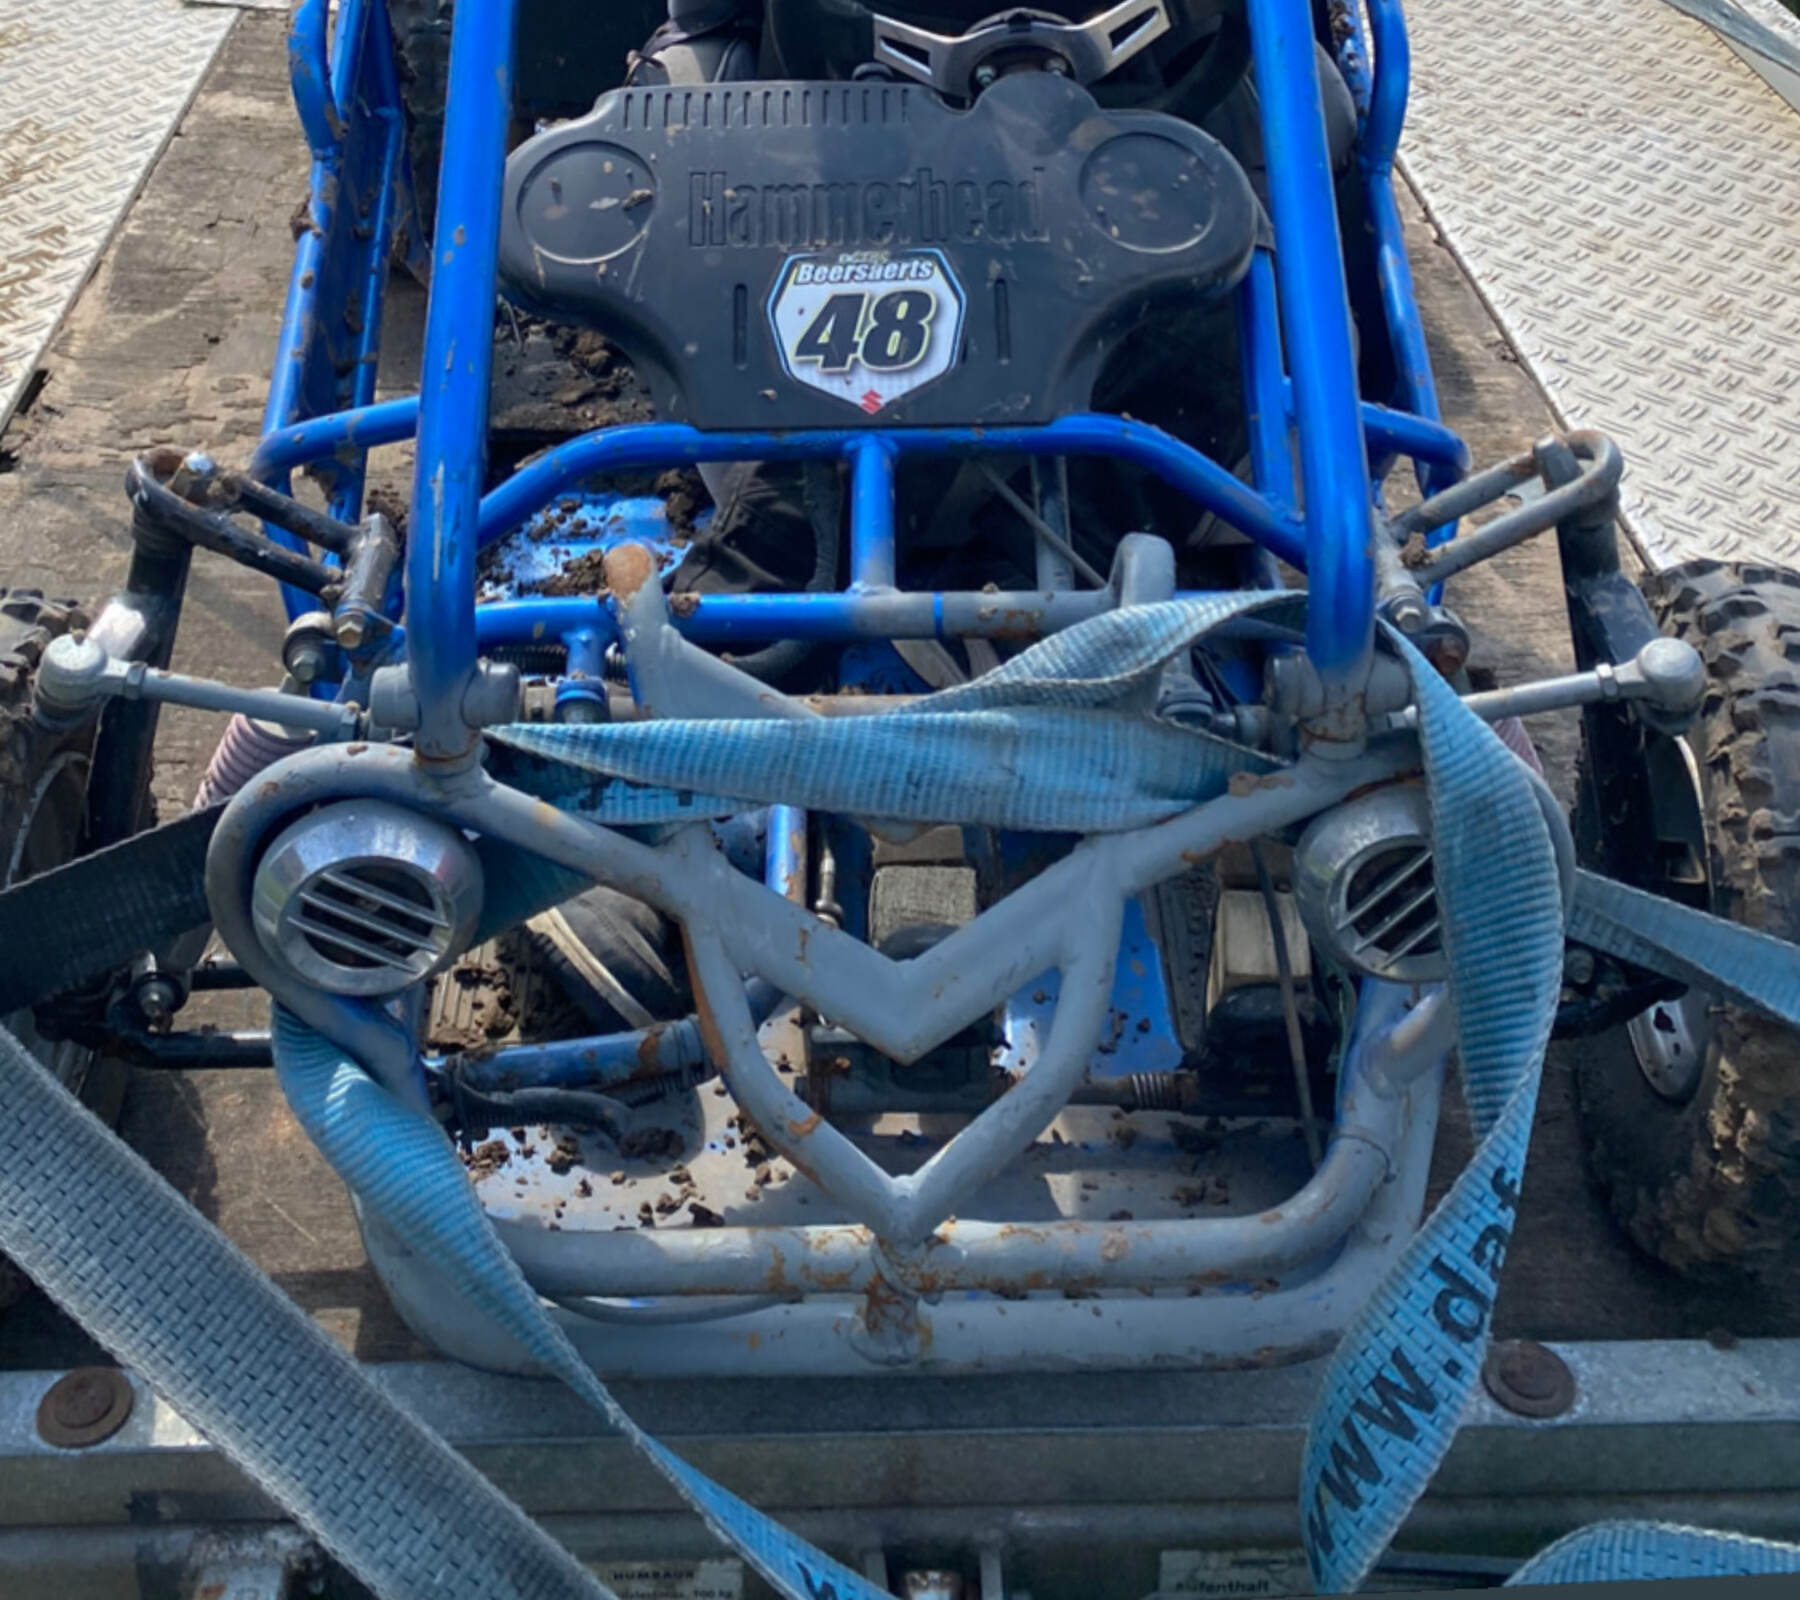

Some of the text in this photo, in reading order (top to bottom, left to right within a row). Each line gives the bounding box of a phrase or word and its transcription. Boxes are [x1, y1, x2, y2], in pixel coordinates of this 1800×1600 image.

[688, 166, 1051, 249] Hammerhead
[795, 260, 934, 284] Beersaerts
[793, 289, 937, 374] 48
